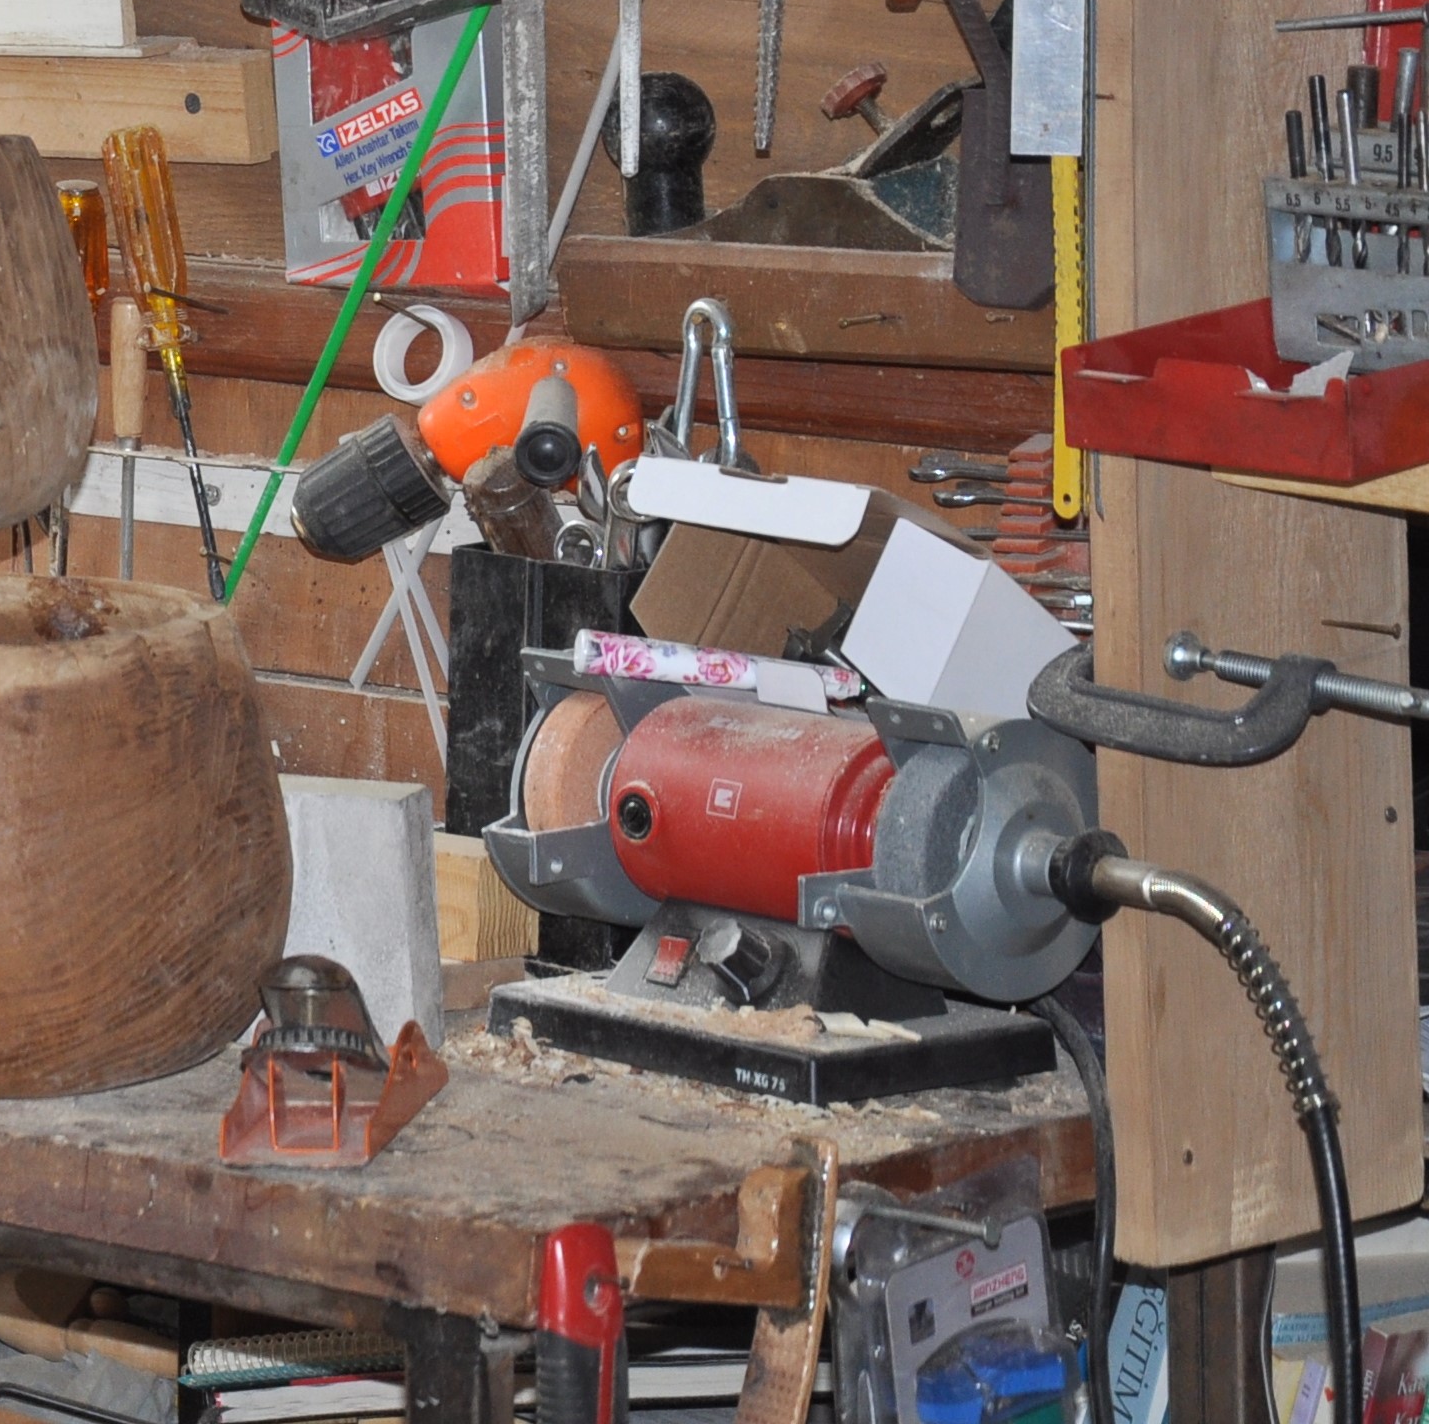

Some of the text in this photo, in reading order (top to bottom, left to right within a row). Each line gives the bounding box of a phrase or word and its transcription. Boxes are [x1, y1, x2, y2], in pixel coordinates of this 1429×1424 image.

[334, 149, 356, 170] Allen
[360, 160, 378, 180] Key
[376, 145, 408, 169] Wrench
